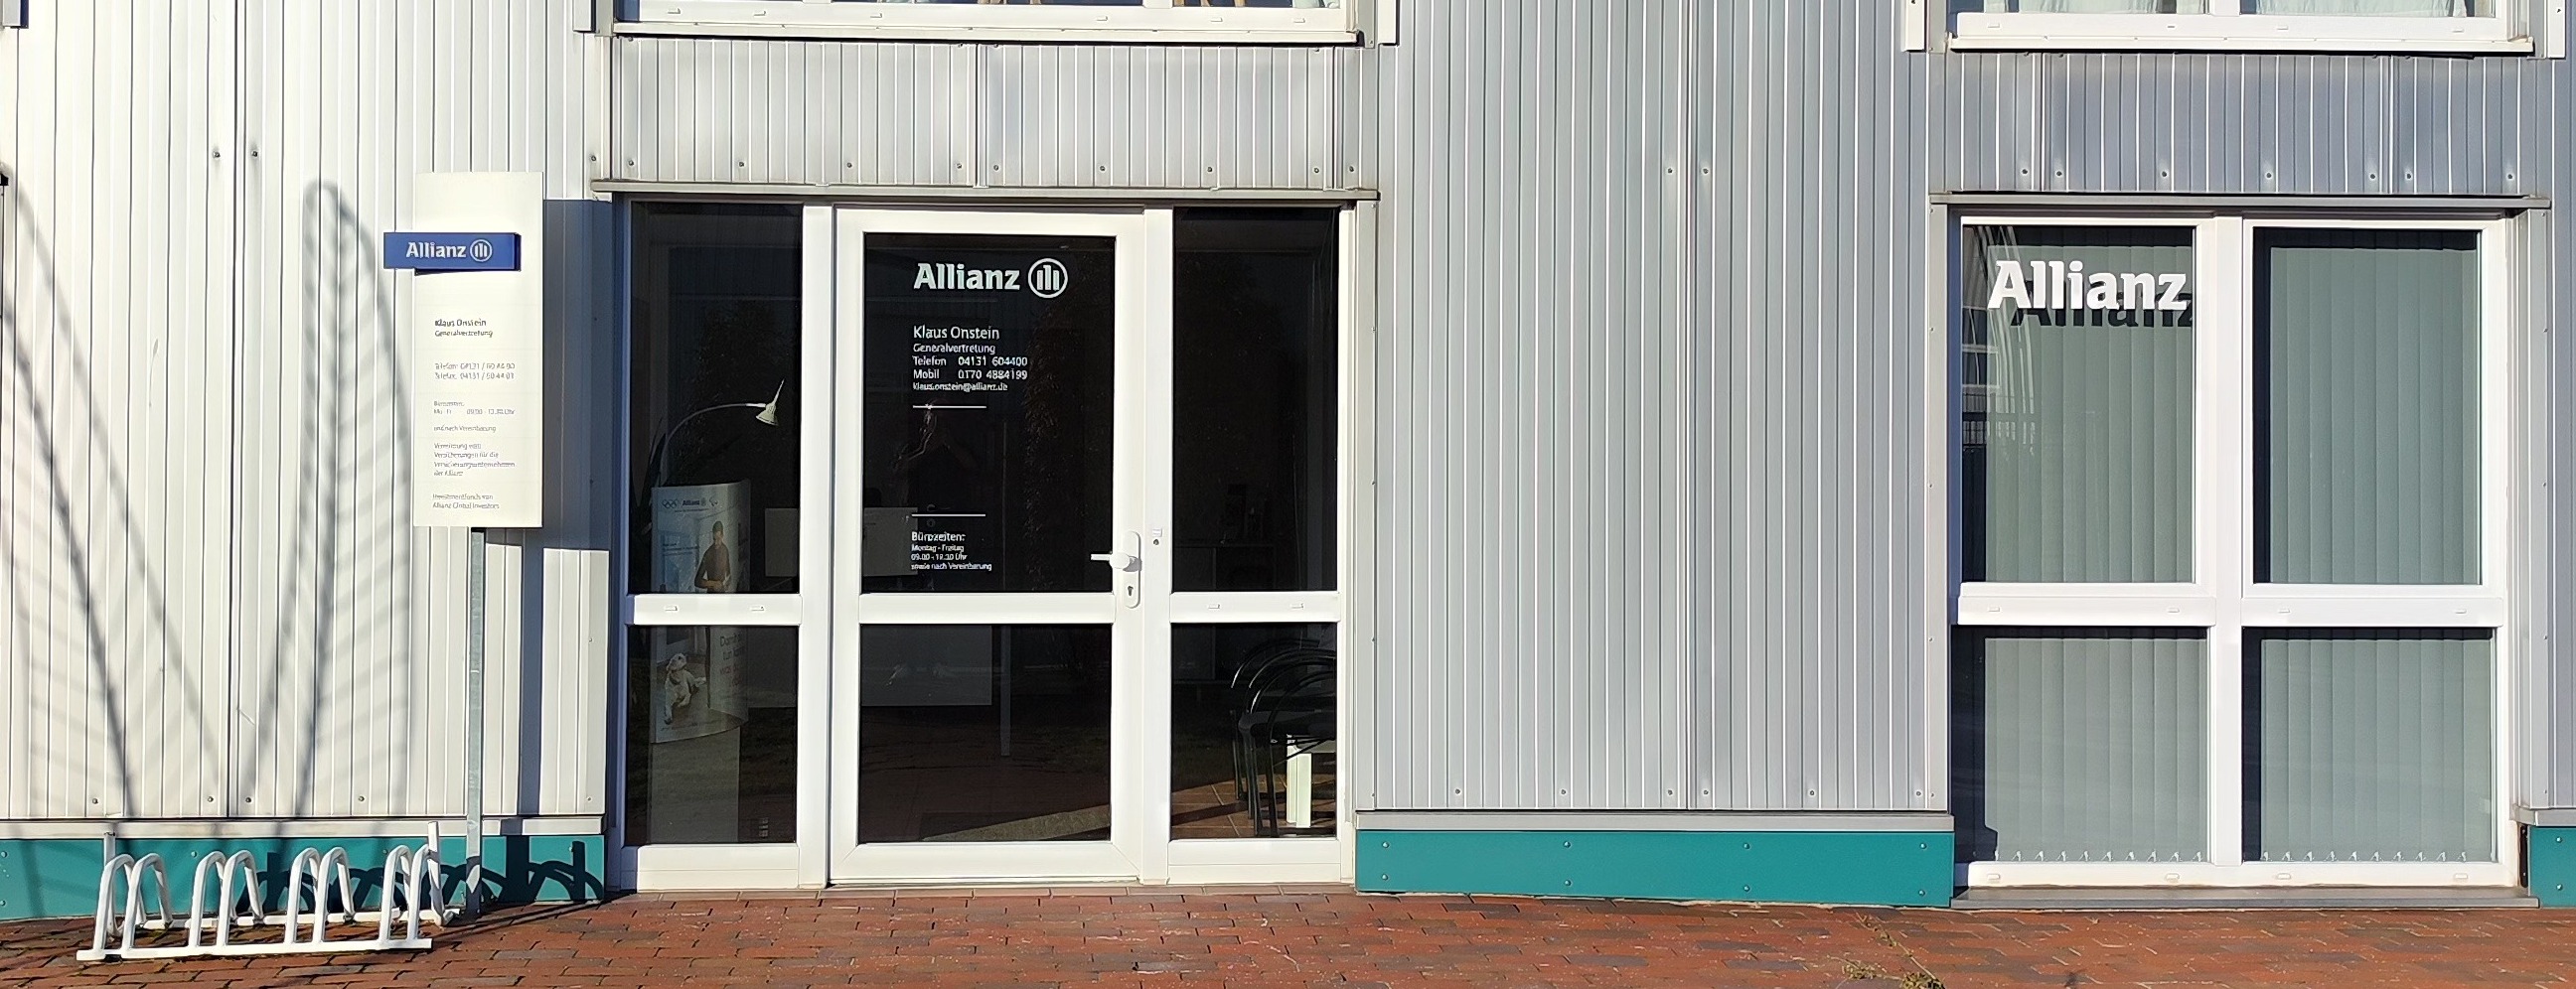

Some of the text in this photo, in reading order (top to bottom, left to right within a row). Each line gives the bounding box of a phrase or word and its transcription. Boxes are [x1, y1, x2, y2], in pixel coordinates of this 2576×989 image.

[405, 241, 467, 259] Allianz
[913, 262, 1021, 291] Allianz
[1987, 260, 2188, 311] Allianz
[456, 318, 487, 327] Onstein
[913, 325, 1000, 340] Klaus Onstein
[912, 343, 996, 355] Generalvertretung
[912, 355, 1028, 366] Telefon 04131 604400
[913, 368, 940, 379] Mobil
[958, 369, 983, 379] 0170
[911, 531, 967, 542] Bürozeiten:
[911, 543, 937, 552] Montag
[955, 552, 968, 561] Uhr
